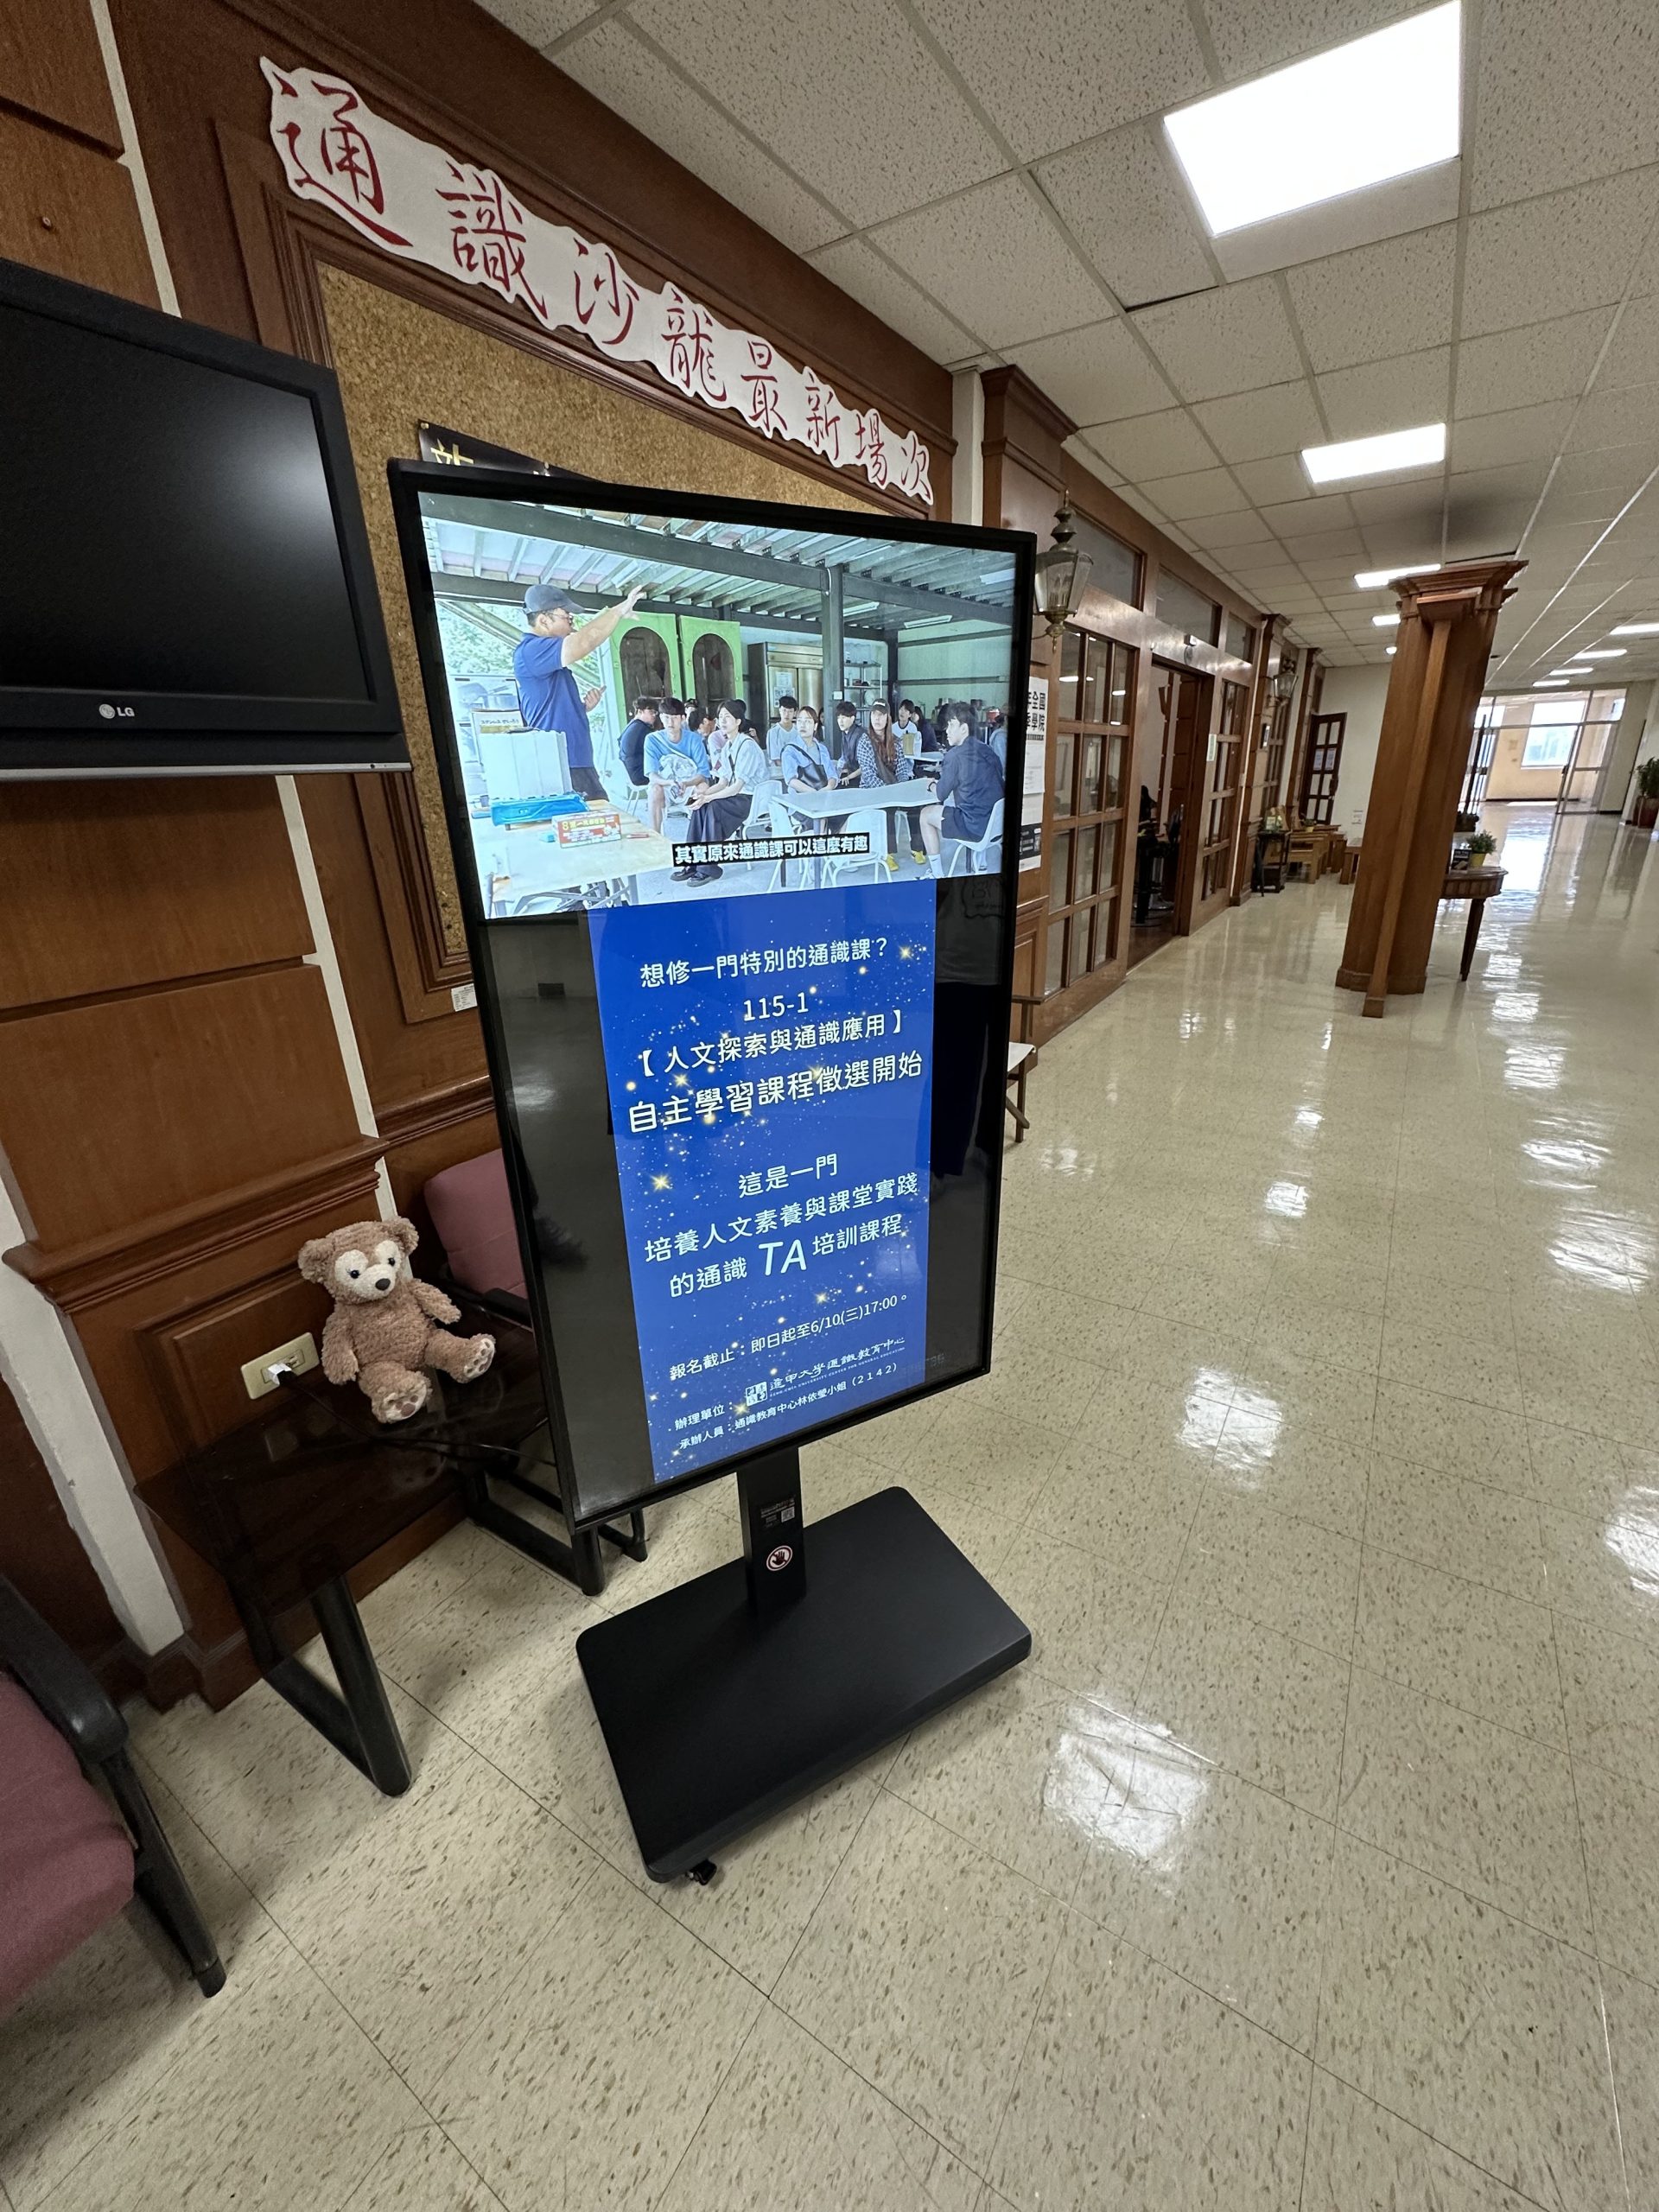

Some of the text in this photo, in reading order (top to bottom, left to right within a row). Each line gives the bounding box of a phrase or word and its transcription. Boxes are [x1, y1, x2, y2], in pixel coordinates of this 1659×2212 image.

[277, 78, 932, 499] 通識沙龍最新場次
[117, 707, 135, 716] LG
[675, 835, 868, 864] 其實原來通識課可以這麼有趣
[639, 938, 887, 988] 想修一門特別的通識課？
[743, 992, 809, 1022] 115-1
[628, 1050, 923, 1134] 自主學習課程徵選開始
[739, 1153, 838, 1198] 這是一門
[644, 1172, 918, 1263] 培養人文素養與課堂實踐
[670, 1213, 903, 1298] 的通識 TA 培訓課程
